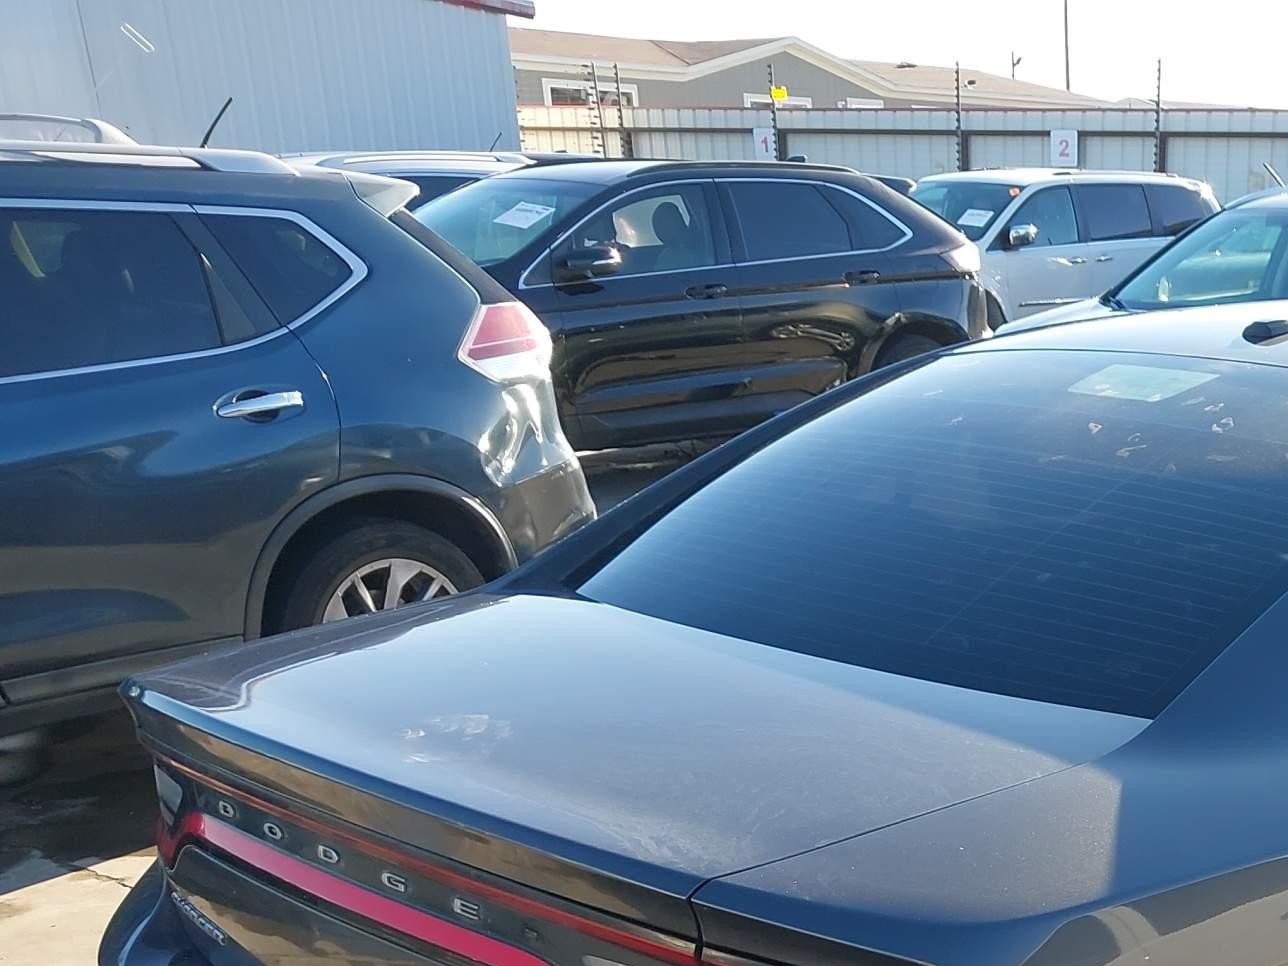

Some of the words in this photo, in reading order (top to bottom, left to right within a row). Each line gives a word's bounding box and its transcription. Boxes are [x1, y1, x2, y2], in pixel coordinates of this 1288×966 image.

[760, 135, 769, 153] 1
[1058, 138, 1070, 158] 2
[217, 799, 482, 921] DODGE
